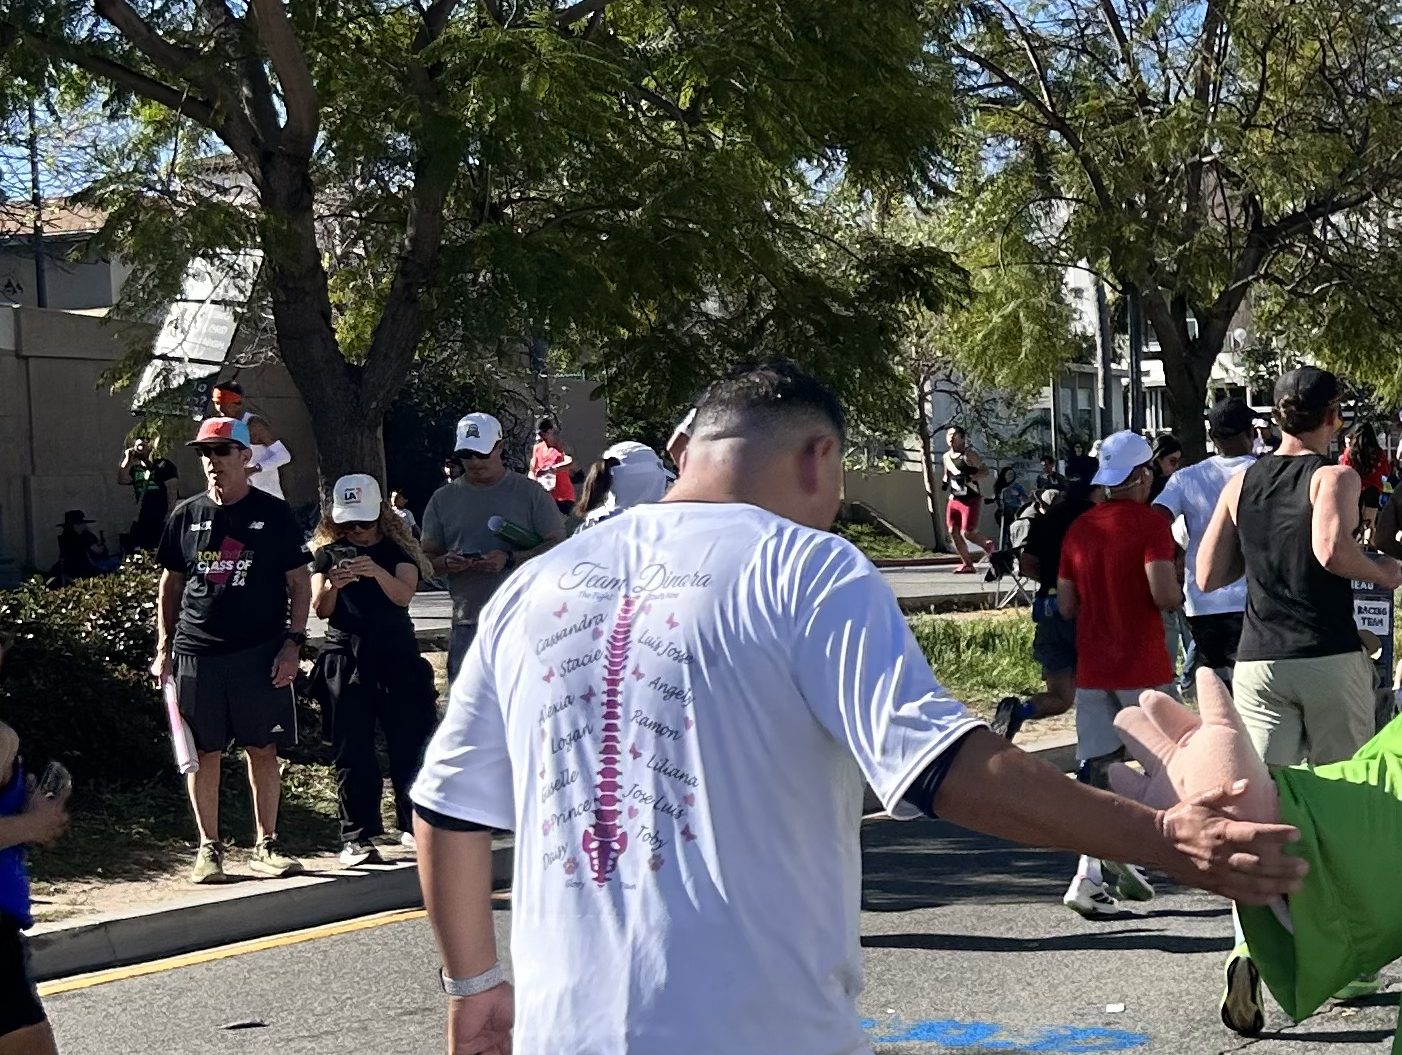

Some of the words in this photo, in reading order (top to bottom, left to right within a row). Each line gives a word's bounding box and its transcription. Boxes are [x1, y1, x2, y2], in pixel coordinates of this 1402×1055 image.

[197, 560, 235, 572] CLASS
[235, 560, 253, 571] OF
[558, 561, 628, 592] Team
[632, 563, 712, 593] Dinora
[1358, 606, 1387, 615] RACING
[1361, 617, 1383, 626] TEAM
[535, 612, 609, 655] Cassandra
[637, 629, 662, 652] Luis
[559, 647, 604, 678] Stacie
[550, 723, 594, 755] Logan
[631, 709, 682, 741] Ramon
[646, 754, 699, 788] Liliana
[549, 799, 594, 832] Prince
[622, 783, 655, 806] Jose
[653, 796, 688, 820] Luis
[635, 825, 668, 851] Toby
[542, 841, 568, 871] Daisy
